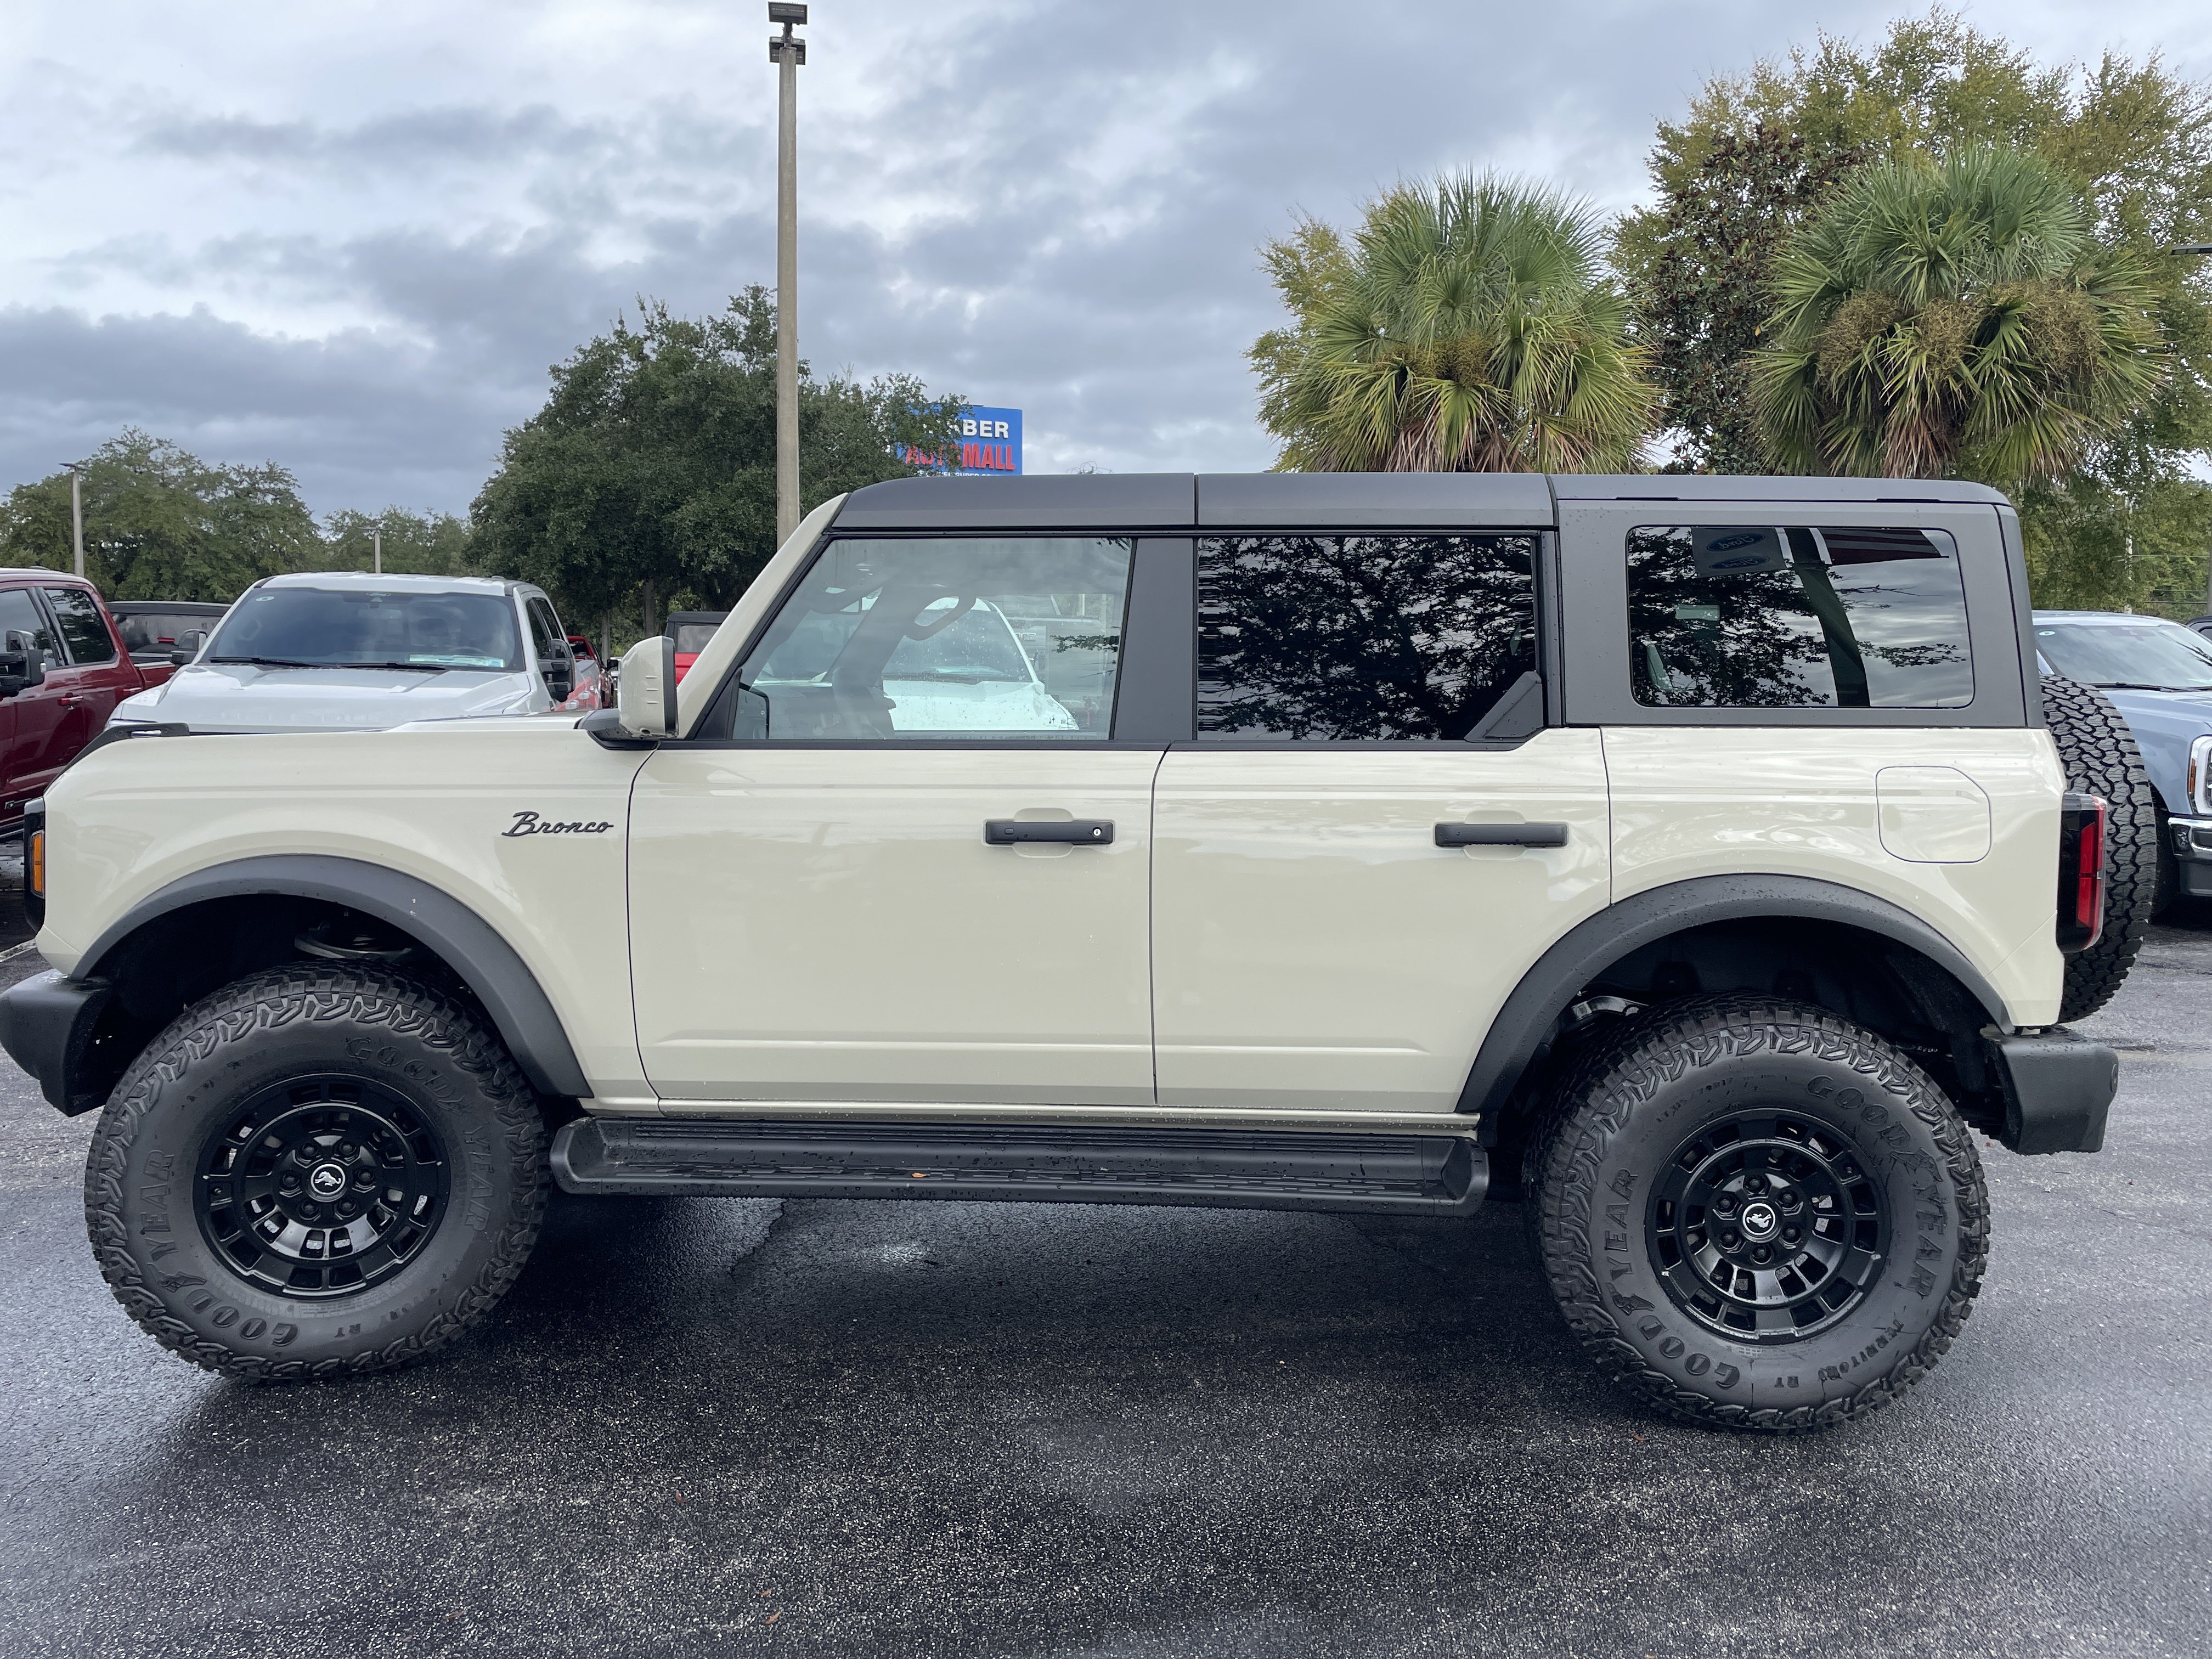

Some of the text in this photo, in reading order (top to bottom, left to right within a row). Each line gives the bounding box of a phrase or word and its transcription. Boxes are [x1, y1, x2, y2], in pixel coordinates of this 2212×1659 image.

[946, 419, 1009, 438] BER
[501, 811, 614, 837] Bronco
[140, 1150, 299, 1346] GOODYEAR
[1605, 1169, 1740, 1389] GOODYEAR
